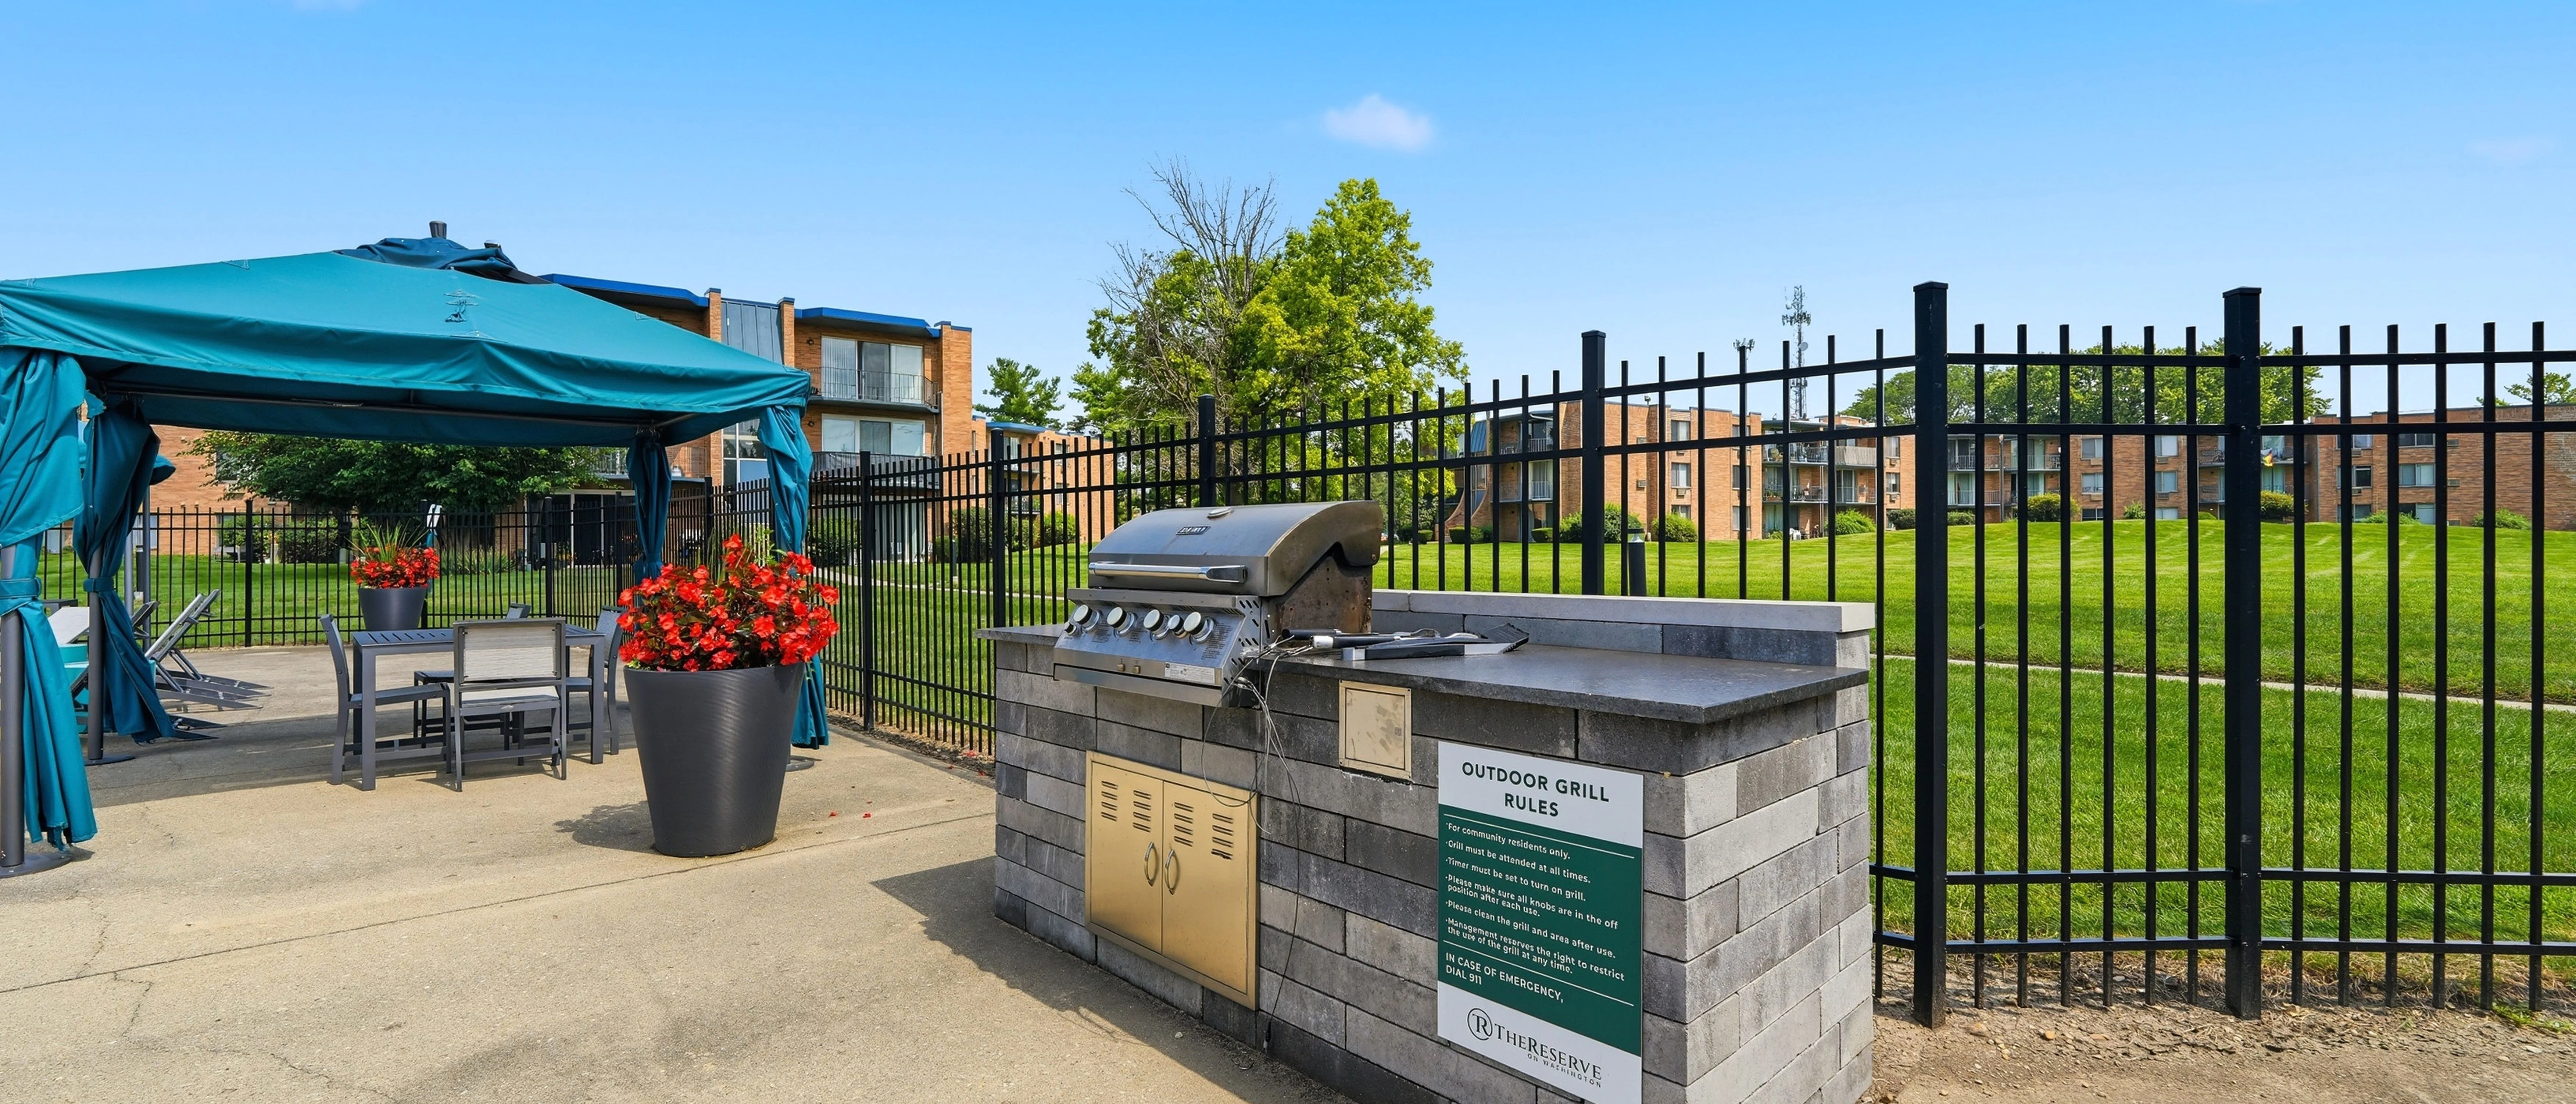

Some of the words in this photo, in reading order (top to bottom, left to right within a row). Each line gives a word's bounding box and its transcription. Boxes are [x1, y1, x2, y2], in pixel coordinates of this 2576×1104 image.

[1462, 762, 1548, 791] OUTDOOR
[1555, 779, 1609, 803] GRILL
[1505, 793, 1559, 817] RULES
[1462, 828, 1506, 845] community
[1508, 839, 1547, 853] residents
[1549, 848, 1570, 860] only.
[1466, 846, 1485, 856] must
[1487, 850, 1496, 859] be
[1499, 854, 1536, 869] attended
[1539, 864, 1547, 872] at
[1550, 866, 1560, 875] all
[1563, 869, 1591, 883] times.
[1493, 869, 1503, 879] be
[1505, 874, 1517, 883] set
[1520, 877, 1528, 886] to
[1531, 880, 1549, 891] turn
[1551, 887, 1563, 895] on
[1565, 890, 1586, 901] grill.
[1480, 893, 1499, 904] after
[1502, 900, 1521, 911] each
[1523, 906, 1540, 917] use.
[1498, 890, 1515, 900] sure
[1517, 895, 1527, 904] all
[1530, 897, 1556, 912] knobs
[1558, 907, 1572, 917] are
[1575, 909, 1584, 920] in
[1586, 914, 1602, 925] the
[1604, 920, 1618, 929] off
[1448, 926, 1460, 936] the
[1488, 939, 1501, 950] the
[1503, 945, 1519, 956] grill
[1522, 951, 1530, 960] at
[1532, 955, 1548, 967] any
[1550, 960, 1573, 974] time.
[1474, 909, 1495, 921] clean
[1497, 916, 1510, 926] the
[1513, 922, 1529, 932] grill
[1532, 927, 1548, 937] and
[1550, 933, 1569, 944] area
[1572, 939, 1593, 951] after
[1597, 947, 1616, 958] use.
[1446, 965, 1467, 980] DIAL
[1469, 973, 1481, 985] 911
[1446, 952, 1455, 963] IN
[1457, 957, 1481, 972] CASE
[1484, 966, 1496, 977] OF
[1499, 971, 1563, 1003] EMERGENCY,
[1536, 946, 1550, 957] the
[1553, 951, 1575, 965] right
[1578, 960, 1587, 969] to
[1590, 964, 1624, 981] restrict
